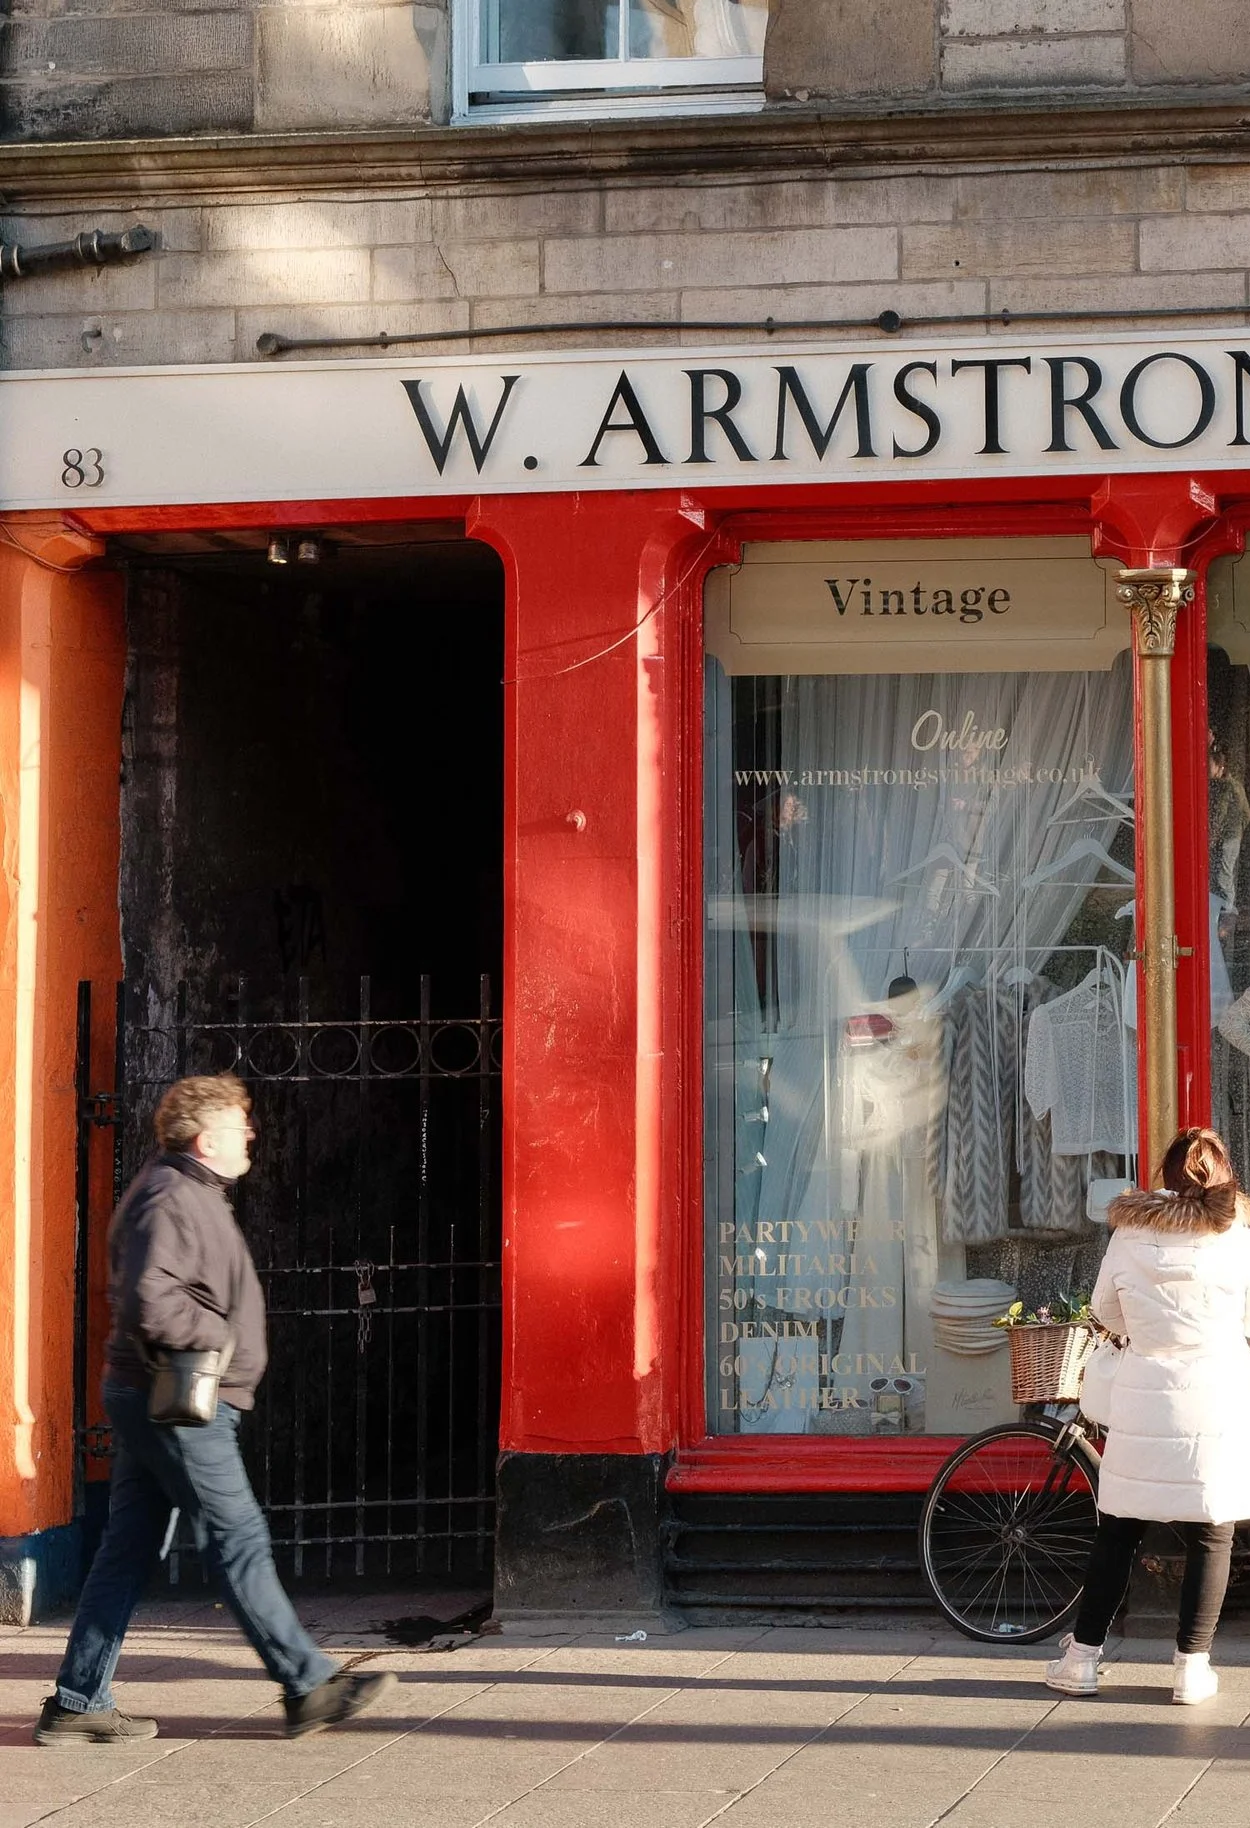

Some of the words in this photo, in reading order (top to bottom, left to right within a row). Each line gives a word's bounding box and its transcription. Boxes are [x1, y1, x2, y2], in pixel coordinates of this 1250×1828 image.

[399, 374, 539, 476] W.
[60, 446, 106, 489] 83
[824, 577, 1011, 625] Vintage
[911, 710, 1009, 752] Online
[734, 761, 1103, 791] www.armstrongsvintage.co.uk
[720, 1220, 906, 1243] PARTYWER
[719, 1253, 878, 1277] MILITARIA
[719, 1287, 768, 1311] 50's
[776, 1286, 898, 1310] FROCKS
[720, 1320, 820, 1344] DENIM
[774, 1352, 927, 1376] ORIGINAL
[719, 1386, 861, 1410] LEATHER
